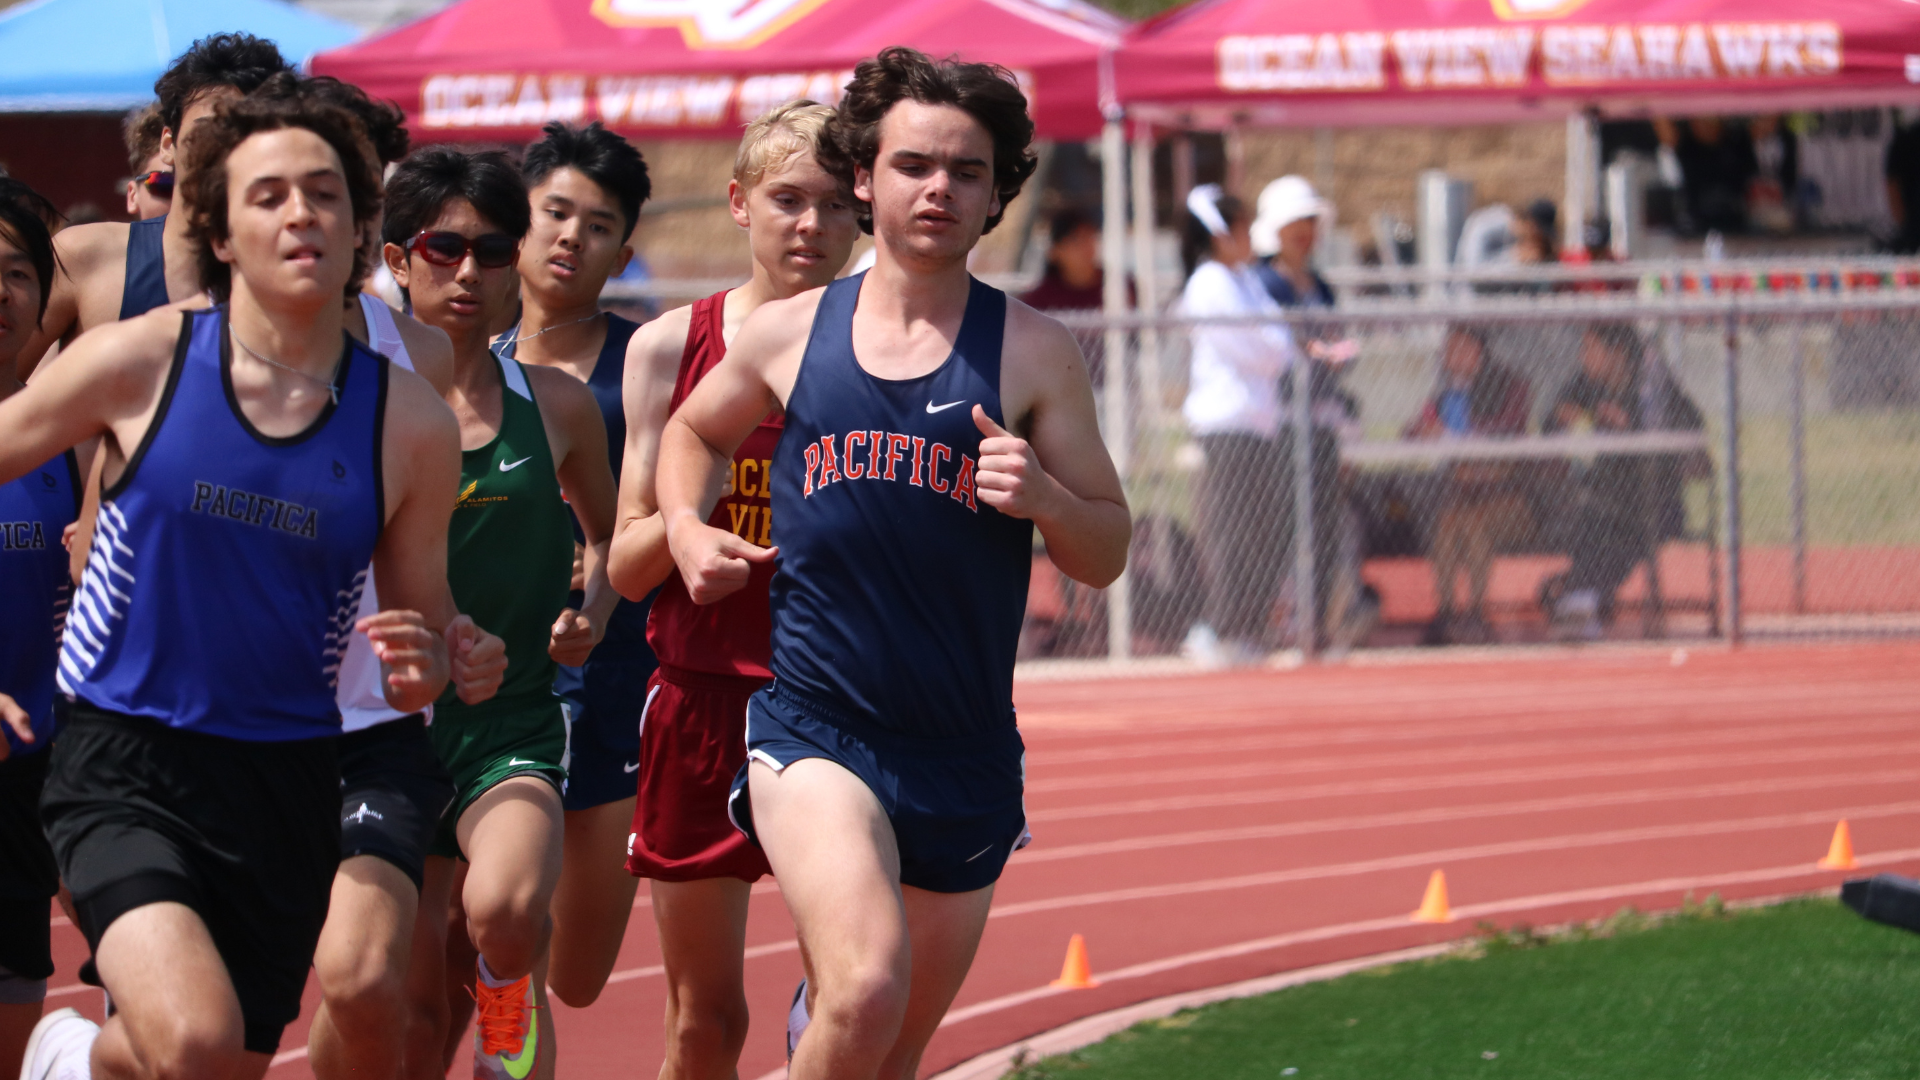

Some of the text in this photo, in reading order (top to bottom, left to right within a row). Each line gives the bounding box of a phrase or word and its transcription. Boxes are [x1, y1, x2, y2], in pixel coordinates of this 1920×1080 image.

[1216, 32, 1387, 91] OCEAN
[1391, 27, 1537, 89] VIEW
[1542, 21, 1843, 86] SEAHAWKS
[420, 73, 590, 127] OCEAN
[596, 73, 736, 126] VIEW
[804, 430, 978, 513] PACIFICA
[0, 521, 46, 550] ICA
[191, 480, 318, 539] PACIFICA
